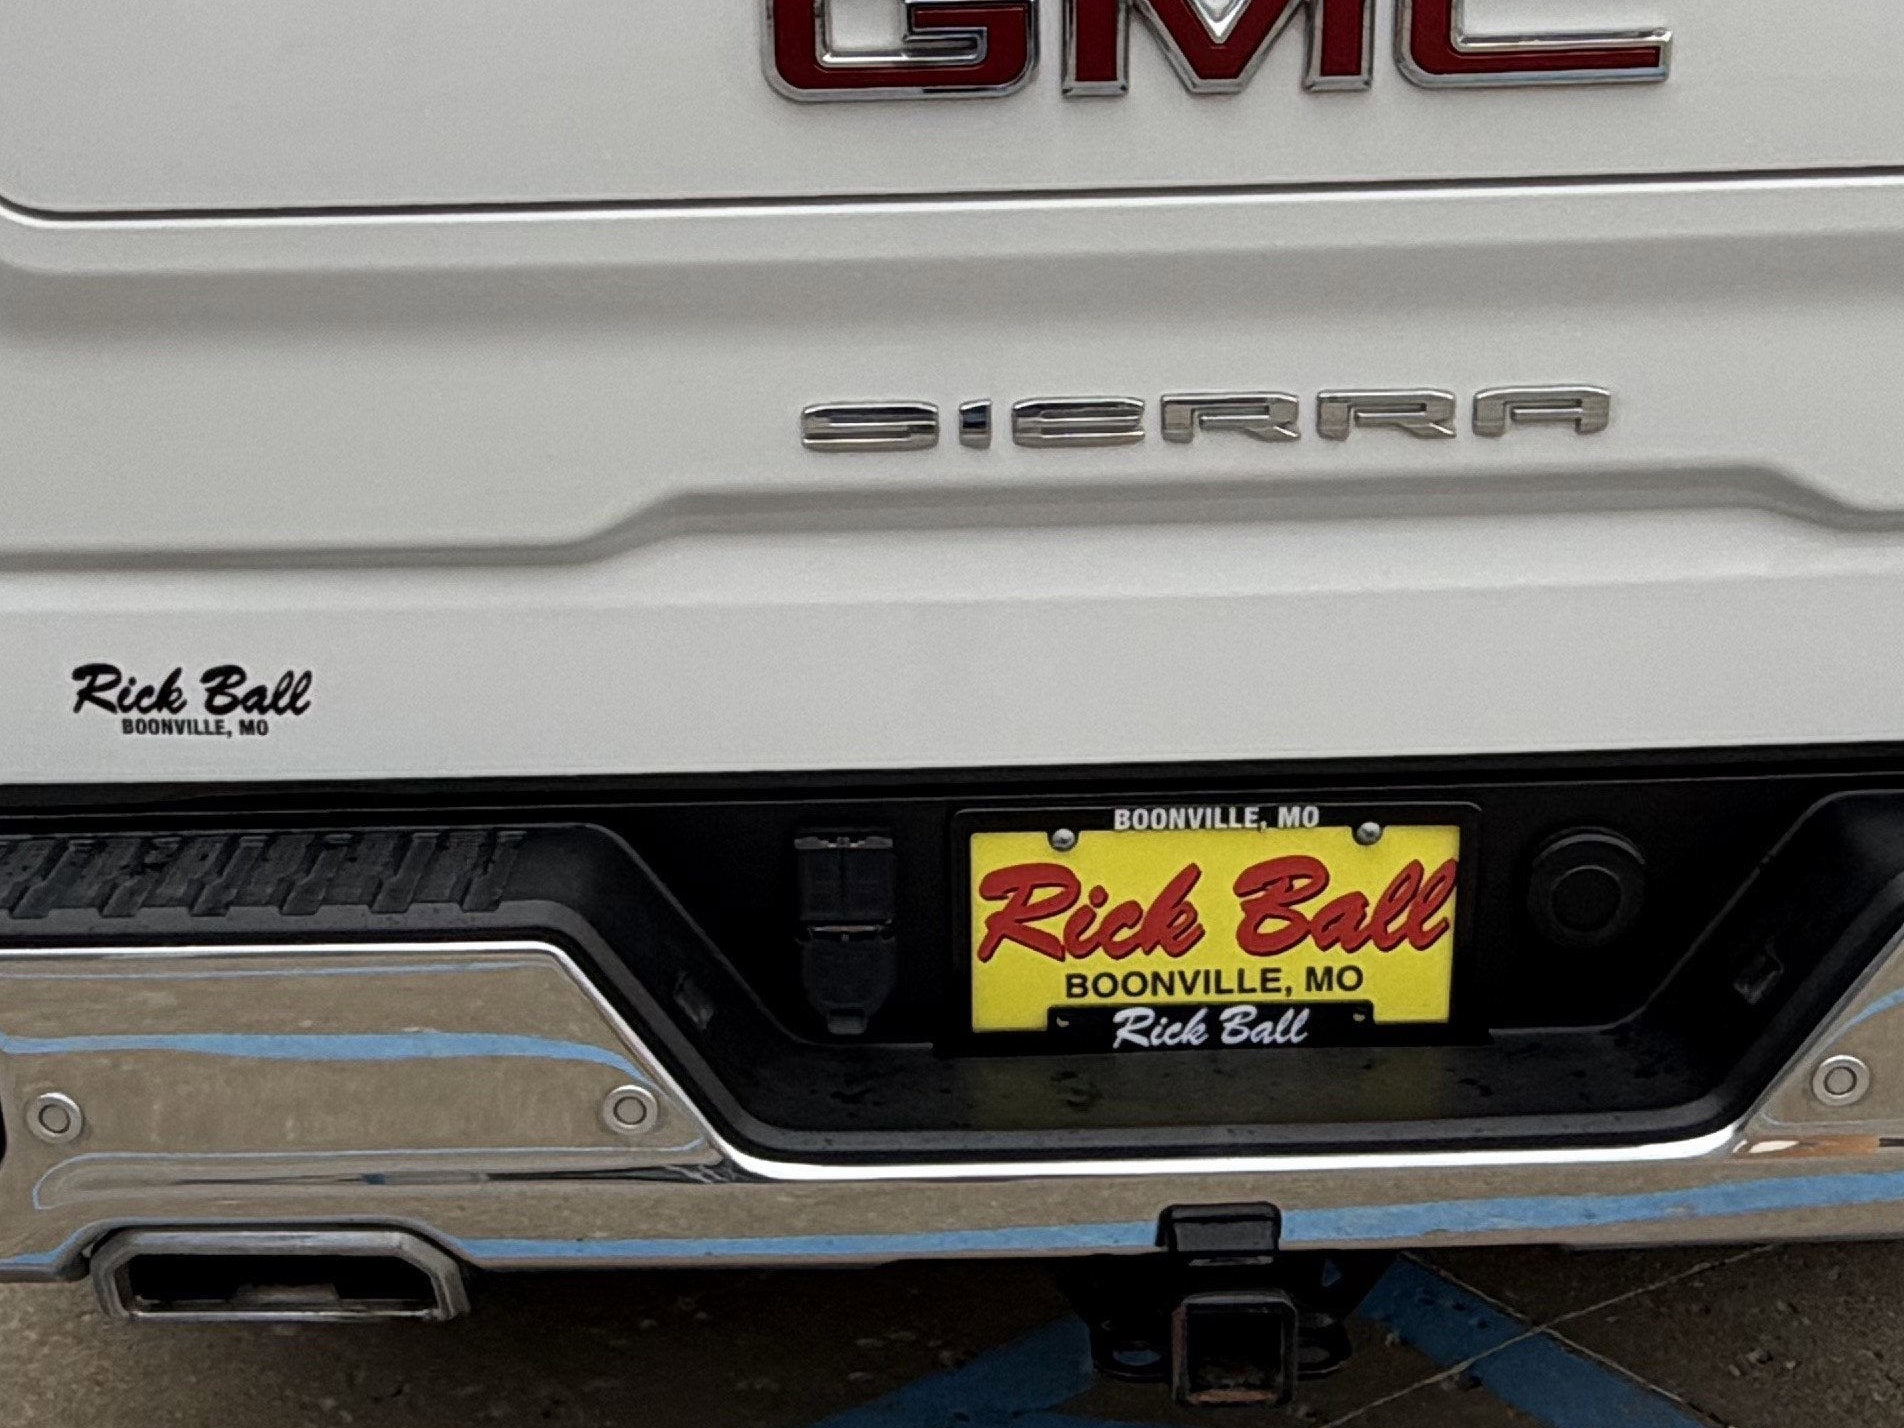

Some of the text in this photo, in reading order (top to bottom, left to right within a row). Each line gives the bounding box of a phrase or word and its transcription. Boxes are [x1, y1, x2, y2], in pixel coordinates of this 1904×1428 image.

[798, 382, 1613, 452] SIERRA
[70, 662, 313, 717] Rick Ball
[120, 717, 270, 739] BOONVILLE, MO
[1113, 805, 1321, 832] BOONVILLE, MO
[976, 854, 1458, 963] Rick Ball
[1063, 965, 1366, 1000] BOONVILLE, MO
[1111, 1004, 1311, 1049] Rick Ball
